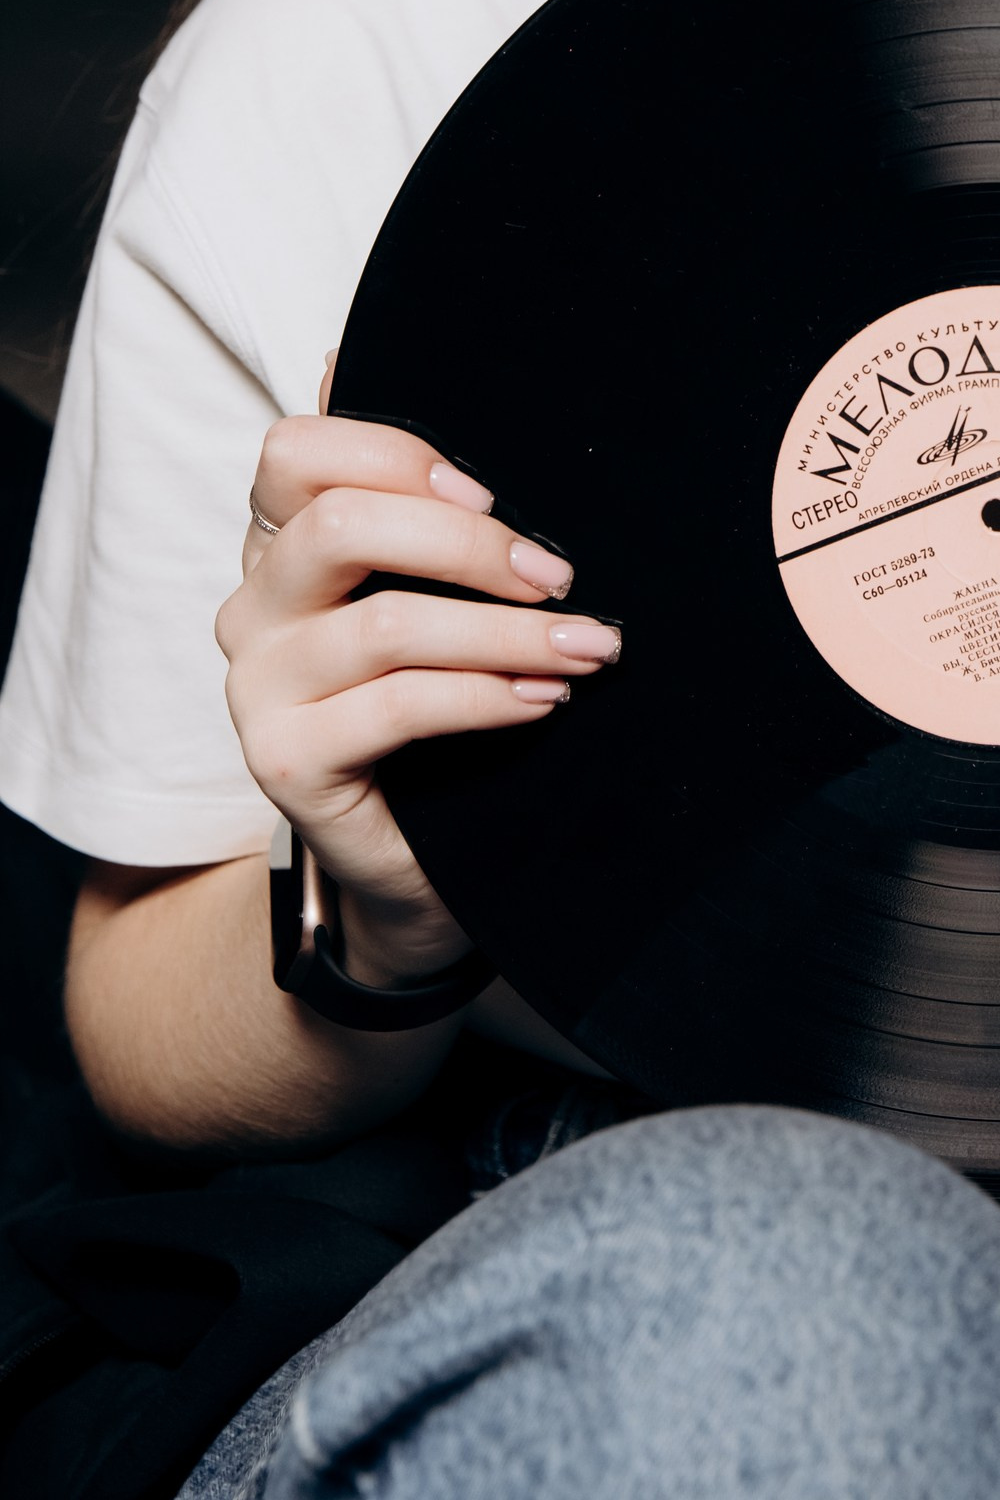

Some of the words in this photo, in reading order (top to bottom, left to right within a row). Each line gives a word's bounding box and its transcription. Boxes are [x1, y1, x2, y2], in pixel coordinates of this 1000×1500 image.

[797, 342, 906, 472] МИНИСТЕРСТВО
[851, 409, 908, 490] ВСЕСОЮЗНАЯ
[910, 384, 955, 411] ФИРМА
[791, 490, 859, 531] СТЕРЕО
[858, 480, 942, 522] АПРЕЛЕВСКИЙ
[945, 462, 994, 486] ОРДЕНА
[853, 564, 887, 586] ГОСТ
[890, 546, 935, 571] 5289-73
[929, 610, 1000, 644] ОКРАСИЛСЯ
[957, 601, 998, 623] русских
[962, 665, 977, 677] Ж.
[974, 673, 985, 683] В.
